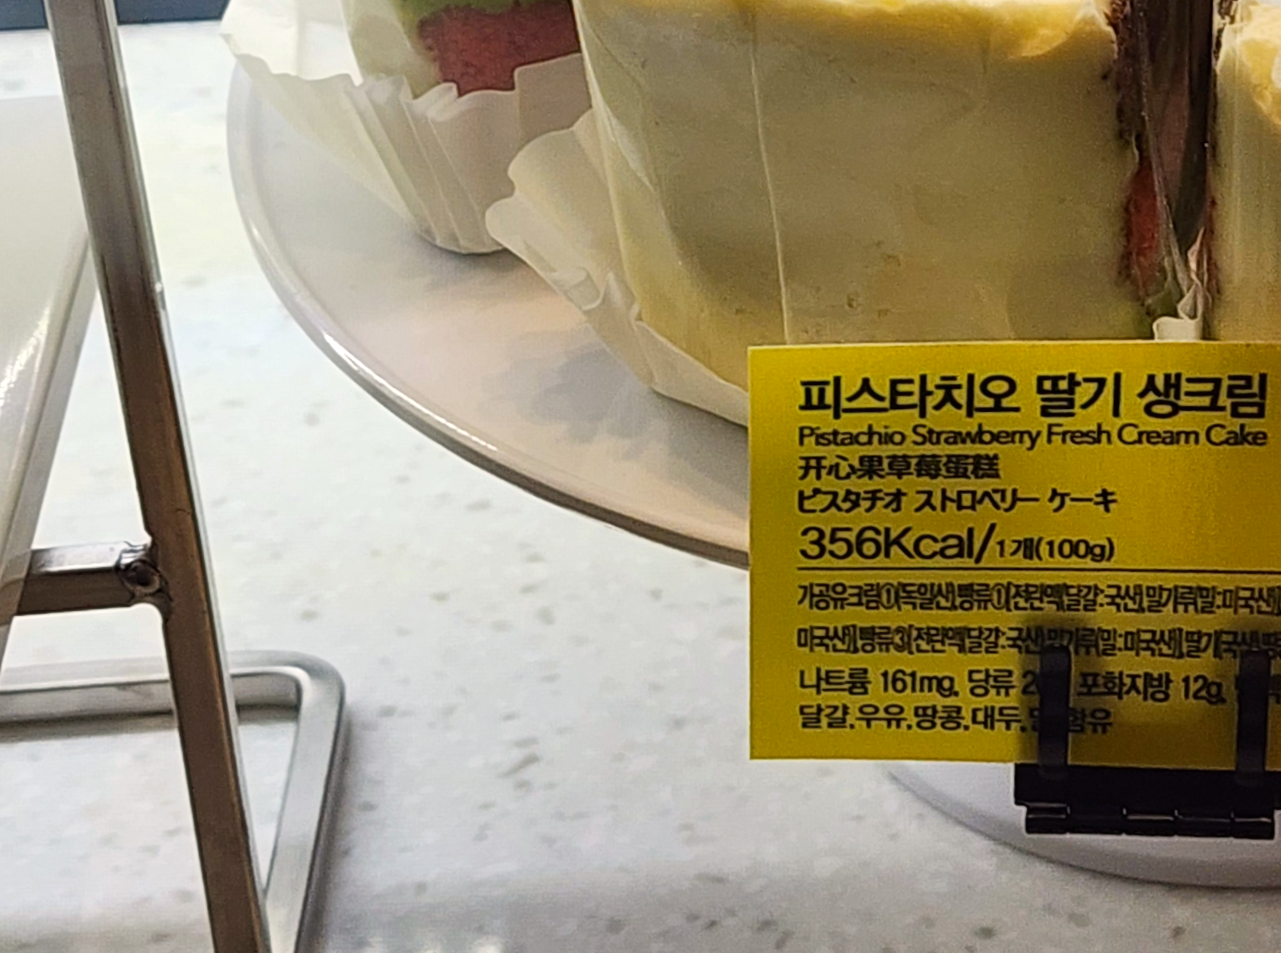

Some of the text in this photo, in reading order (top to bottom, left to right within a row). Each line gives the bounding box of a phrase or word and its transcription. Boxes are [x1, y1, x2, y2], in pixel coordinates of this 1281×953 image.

[799, 373, 1021, 420] 피스타치오
[1036, 372, 1121, 419] 딸기
[1137, 372, 1267, 419] 생크림
[798, 423, 1268, 451] Pistachio Strawberry Fresh Cream Cake
[798, 453, 1001, 481] 开心果草莓蛋糕
[914, 488, 1040, 513] ストロベリー
[1048, 488, 1118, 513] ケーキ
[799, 667, 872, 695] 나트륨
[968, 668, 1018, 697] 당류
[1077, 670, 1173, 702] 포화지방
